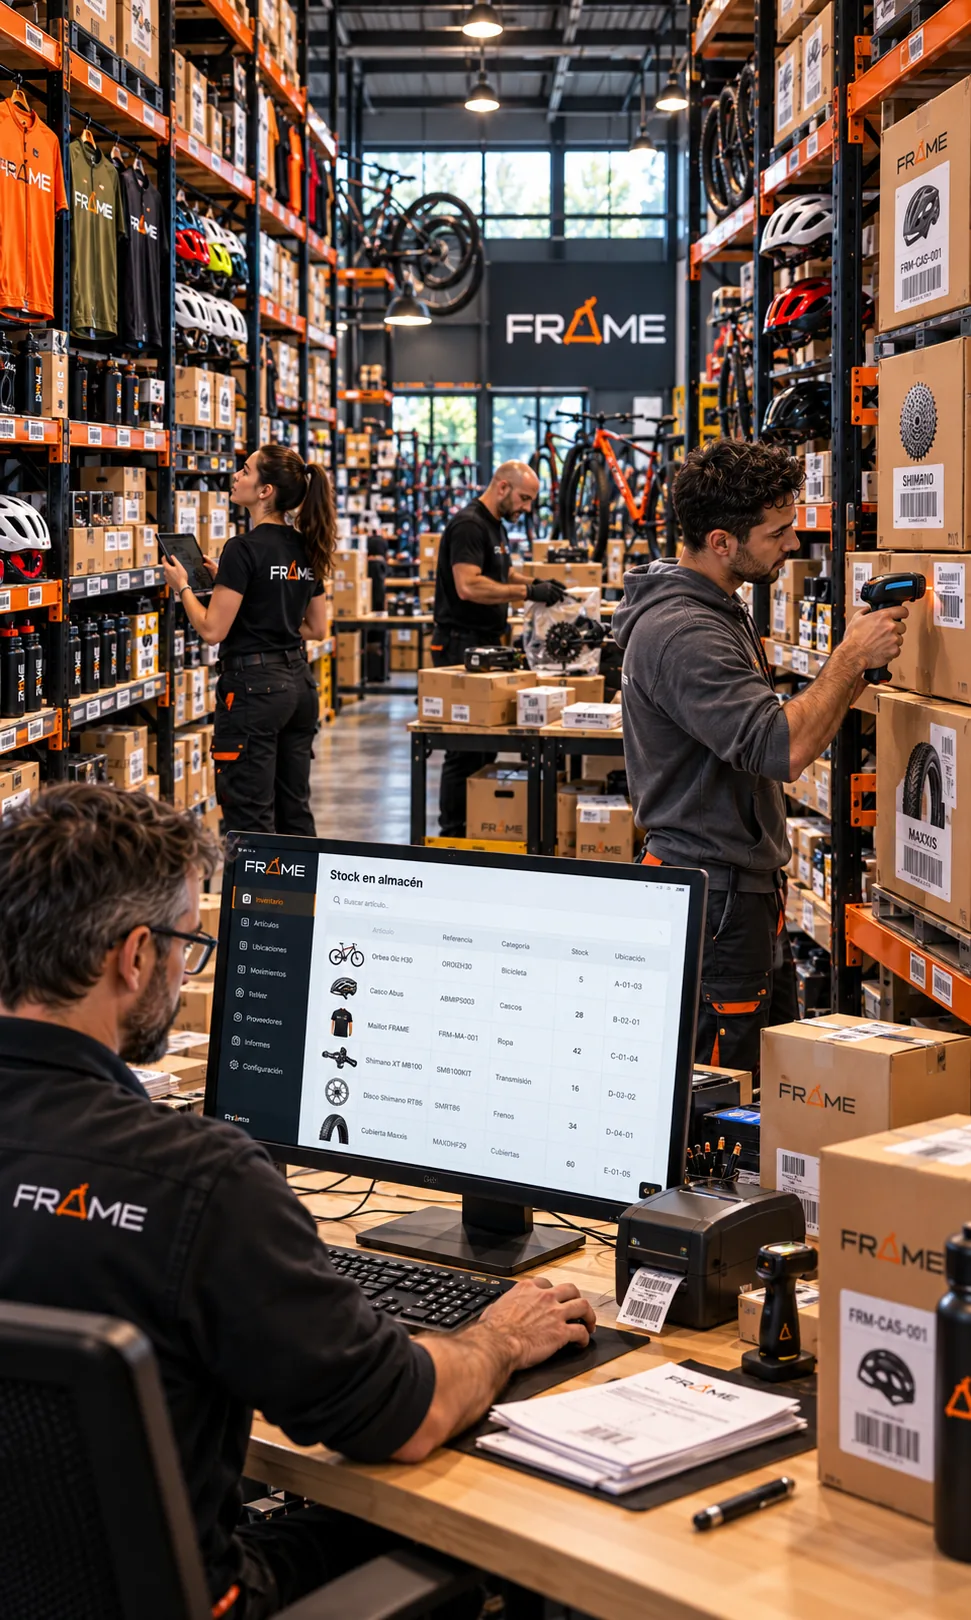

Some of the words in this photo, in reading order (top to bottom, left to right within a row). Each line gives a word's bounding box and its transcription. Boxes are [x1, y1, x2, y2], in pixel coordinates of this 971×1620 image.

[897, 131, 948, 174] FRAME
[74, 191, 113, 220] FRAME
[130, 215, 158, 240] FRAME
[900, 248, 942, 275] FRM-CAS-001
[505, 296, 667, 345] FRAME
[902, 473, 934, 487] SHIMANO
[270, 560, 315, 580] FRAME
[481, 820, 523, 834] FRAME
[908, 827, 938, 850] MAXXIS
[244, 857, 306, 877] FRAME
[330, 869, 360, 883] Stock
[362, 875, 375, 883] en
[378, 874, 424, 889] almacén
[343, 897, 363, 905] Buscar
[442, 934, 472, 943] Referencia
[252, 943, 286, 953] Ubicaciones
[571, 948, 588, 956] Stock
[371, 952, 389, 961] Orbea
[614, 952, 645, 962] Ubicación
[501, 967, 527, 976] Bicicleta
[614, 981, 642, 990] A-01-03
[369, 987, 387, 995] Casco
[388, 989, 403, 997] Abus
[499, 1002, 522, 1011] Cascos
[246, 1014, 282, 1025] Proveedores
[612, 1016, 640, 1025] B-02-01
[367, 1022, 387, 1030] Maillot
[388, 1024, 409, 1032] FRAME
[438, 1030, 478, 1041] FRM-MA-001
[497, 1037, 513, 1046] Ropa
[365, 1056, 391, 1066] Shimano
[610, 1052, 638, 1062] C-01-04
[242, 1062, 284, 1076] Configuración
[495, 1073, 531, 1085] Transmisión
[571, 1084, 579, 1092] 16
[363, 1091, 379, 1100] Disco
[380, 1094, 406, 1104] Shimano
[608, 1090, 636, 1100] D-03-02
[778, 1084, 856, 1115] FRAME
[493, 1110, 514, 1120] Frenos
[568, 1122, 577, 1130] 34
[360, 1127, 385, 1137] Cubierta
[387, 1130, 407, 1140] Maxxis
[605, 1128, 633, 1139] D-04-01
[490, 1147, 519, 1159] Cubiertas
[565, 1160, 575, 1168] 60
[603, 1167, 631, 1178] E-01-05
[13, 1183, 149, 1233] FRAME
[840, 1229, 945, 1274] FRAME
[848, 1307, 929, 1343] FRM-CAS-001
[665, 1375, 740, 1402] FRAME
